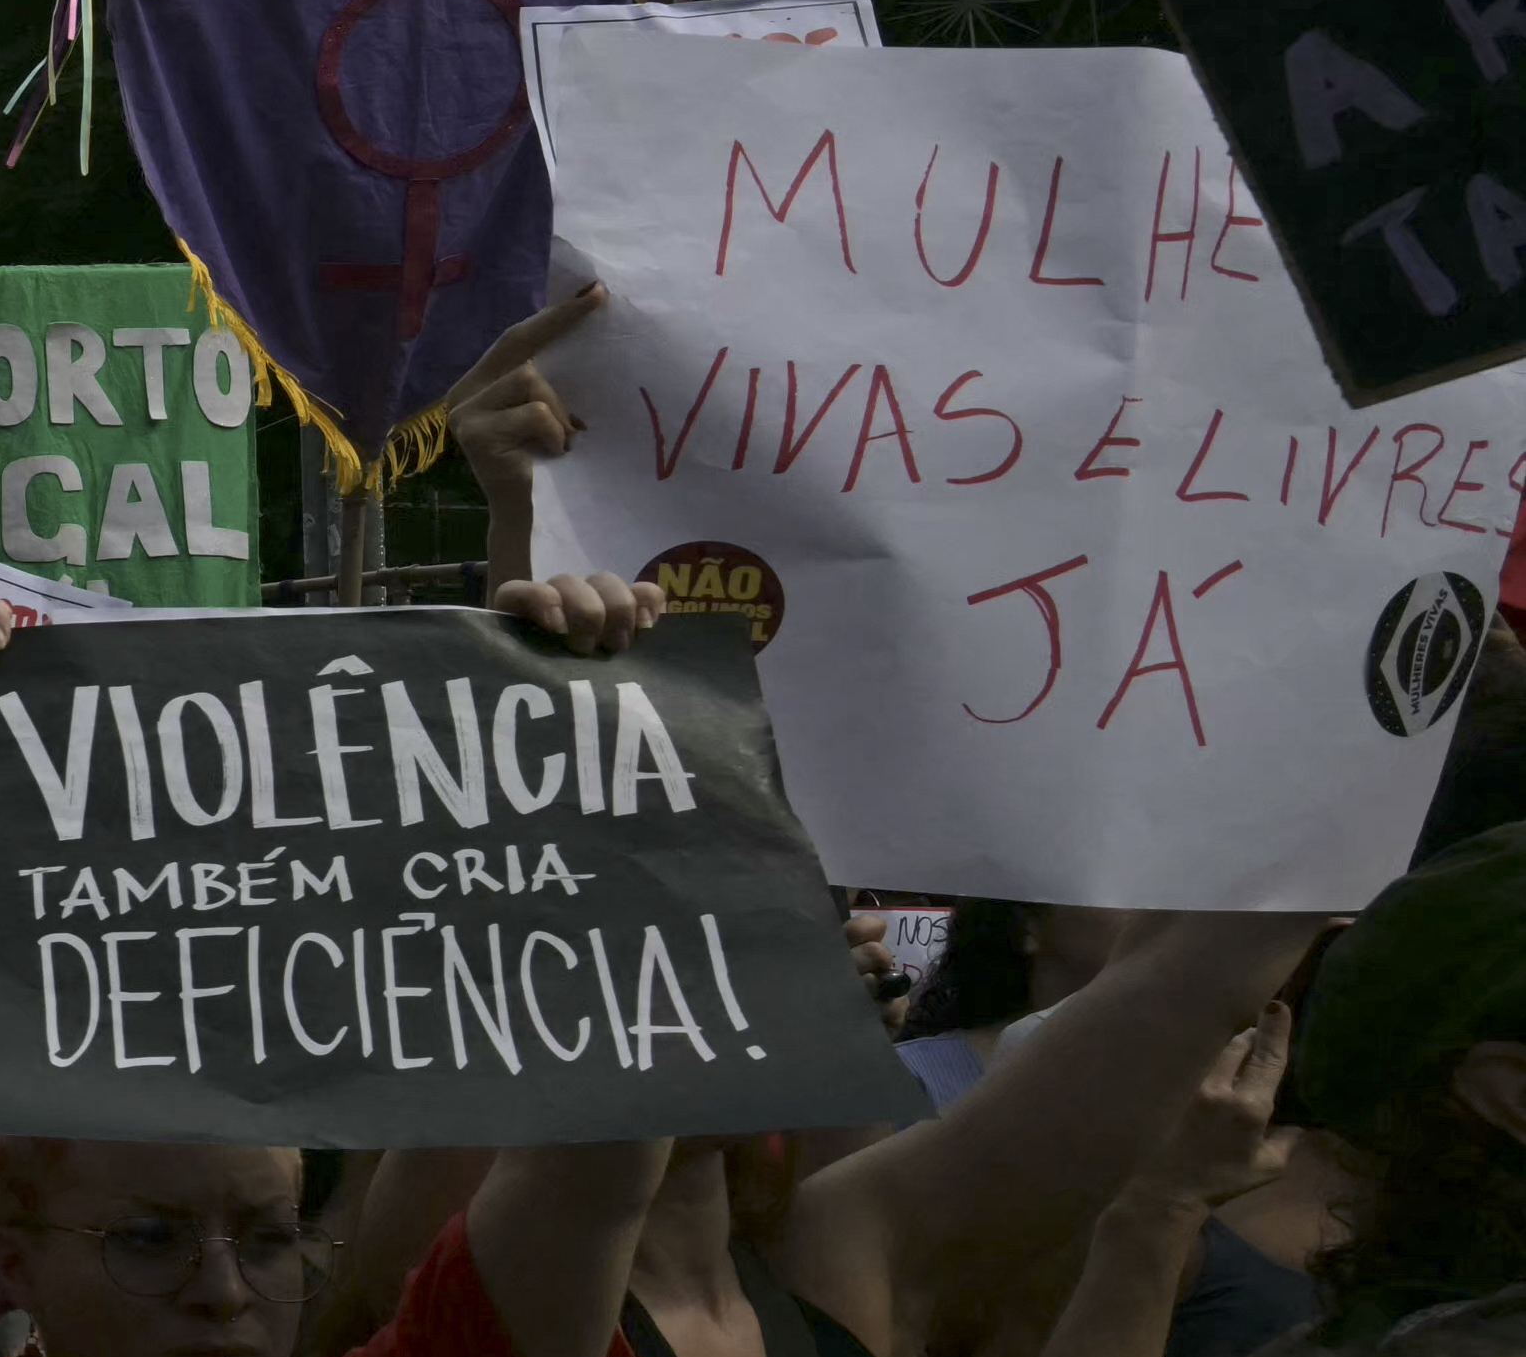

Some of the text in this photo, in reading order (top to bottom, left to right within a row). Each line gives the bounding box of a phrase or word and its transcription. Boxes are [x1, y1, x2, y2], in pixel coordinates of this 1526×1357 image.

[639, 346, 1023, 492] VIVAS
[1074, 396, 1142, 481] E
[657, 557, 763, 600] NÃO
[962, 555, 1243, 747] JÁ
[1409, 588, 1449, 716] MULHERES VIVAS
[18, 843, 595, 921] TAMBÉM CRIA
[38, 910, 766, 1076] DEFICIÊNCIA!
